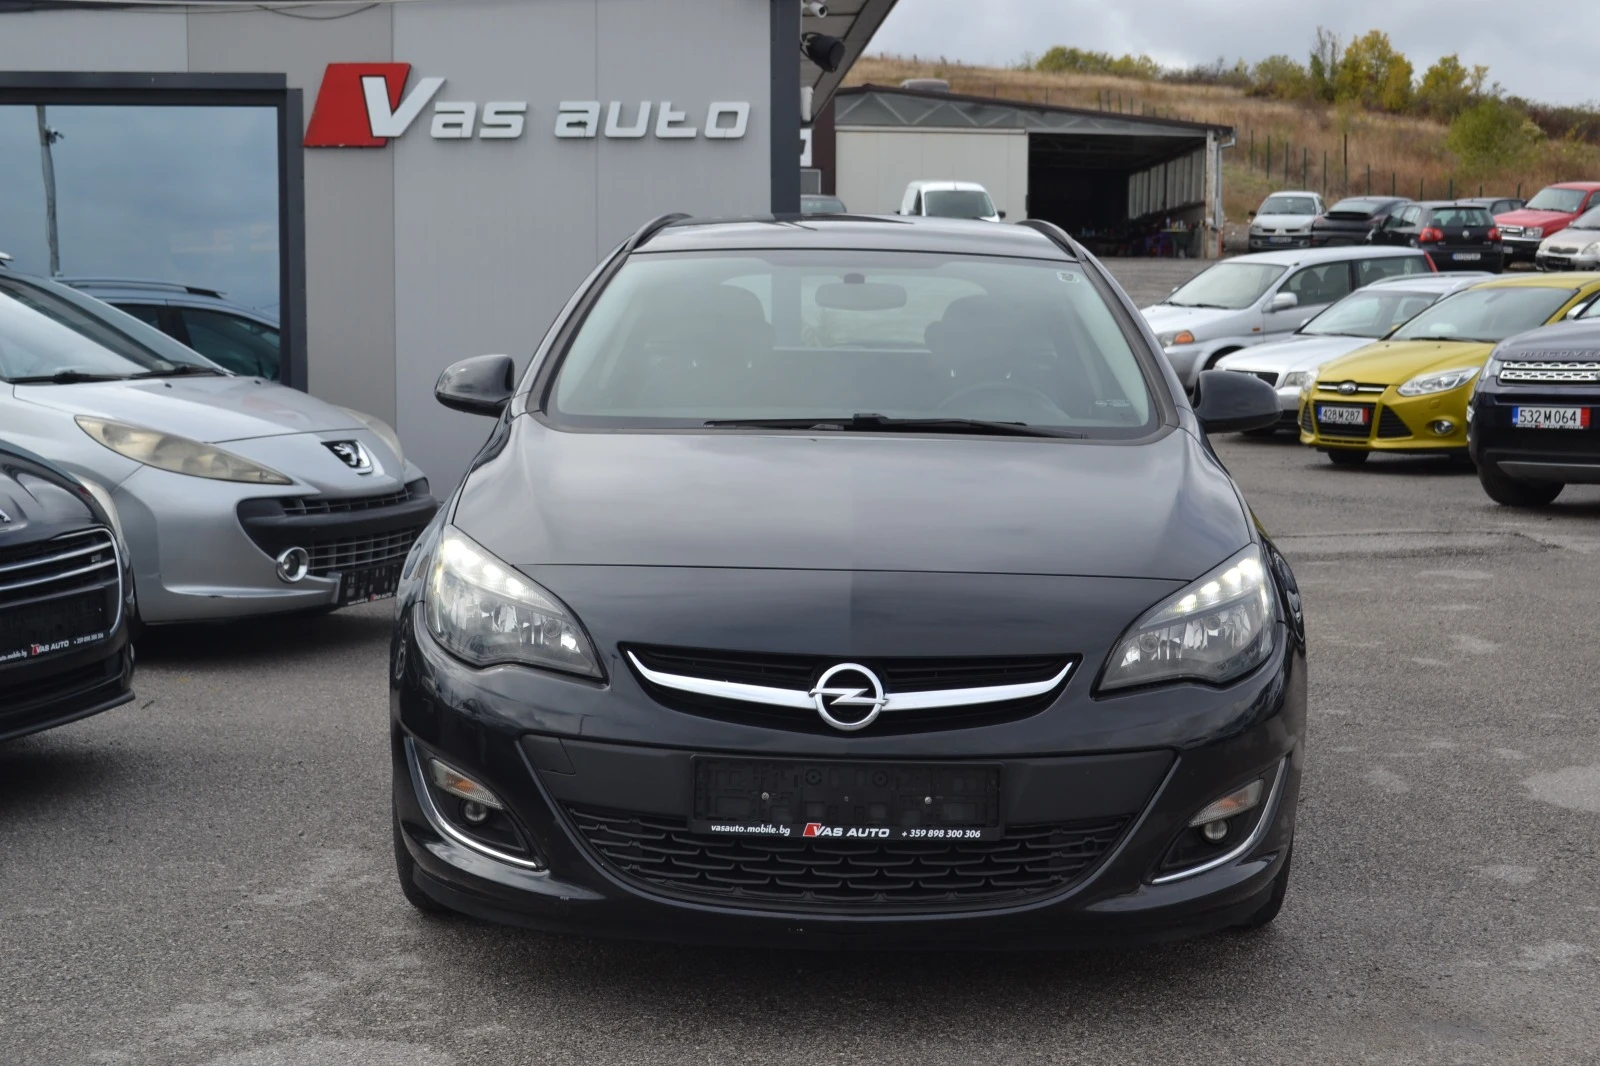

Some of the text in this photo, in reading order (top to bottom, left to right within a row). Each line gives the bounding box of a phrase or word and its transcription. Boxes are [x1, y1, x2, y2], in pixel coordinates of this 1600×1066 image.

[50, 640, 70, 651] AUTO
[711, 824, 791, 836] vasauto.mobile.bg
[813, 825, 844, 837] VAS
[846, 827, 890, 838] AUTO
[909, 829, 926, 838] 359
[927, 829, 945, 838] 898
[946, 829, 963, 838] 300
[964, 830, 981, 838] 306
